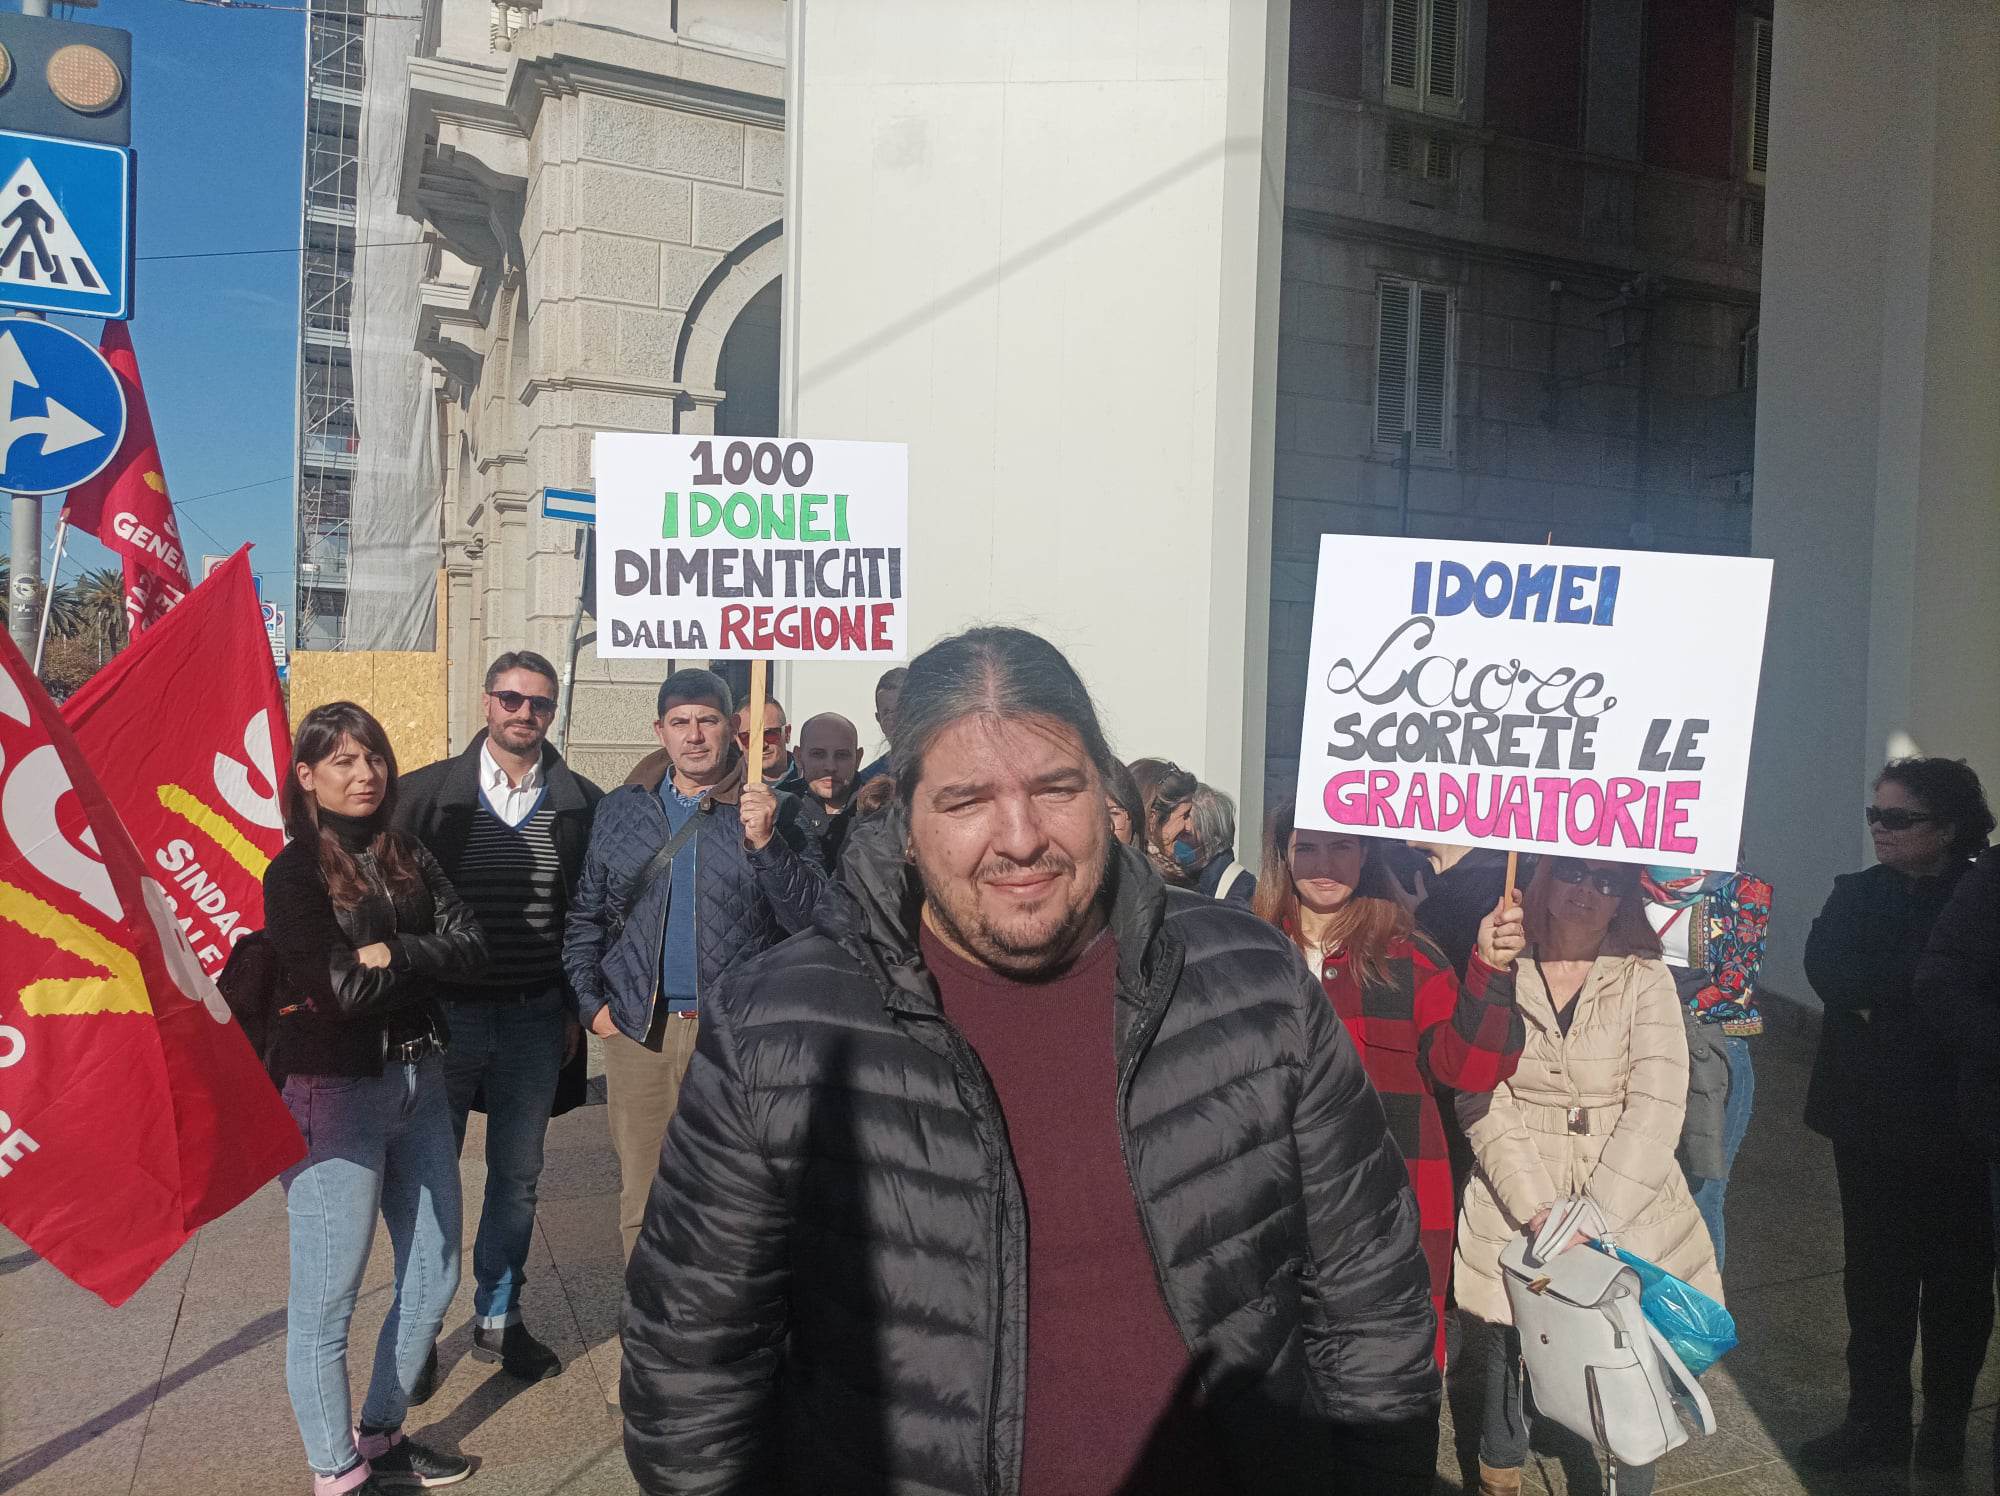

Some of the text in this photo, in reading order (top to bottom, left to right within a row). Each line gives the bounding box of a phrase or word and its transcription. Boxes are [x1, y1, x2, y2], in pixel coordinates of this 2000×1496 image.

[690, 441, 814, 488] 1000
[662, 492, 851, 542] IDONEI
[614, 548, 902, 600] DIMENTICATI
[1411, 560, 1621, 627] IDONEI
[612, 602, 895, 651] DALLA REGIONE
[1327, 710, 1710, 772] SCORRETE LE
[1323, 770, 1701, 854] GRADUATORIE
